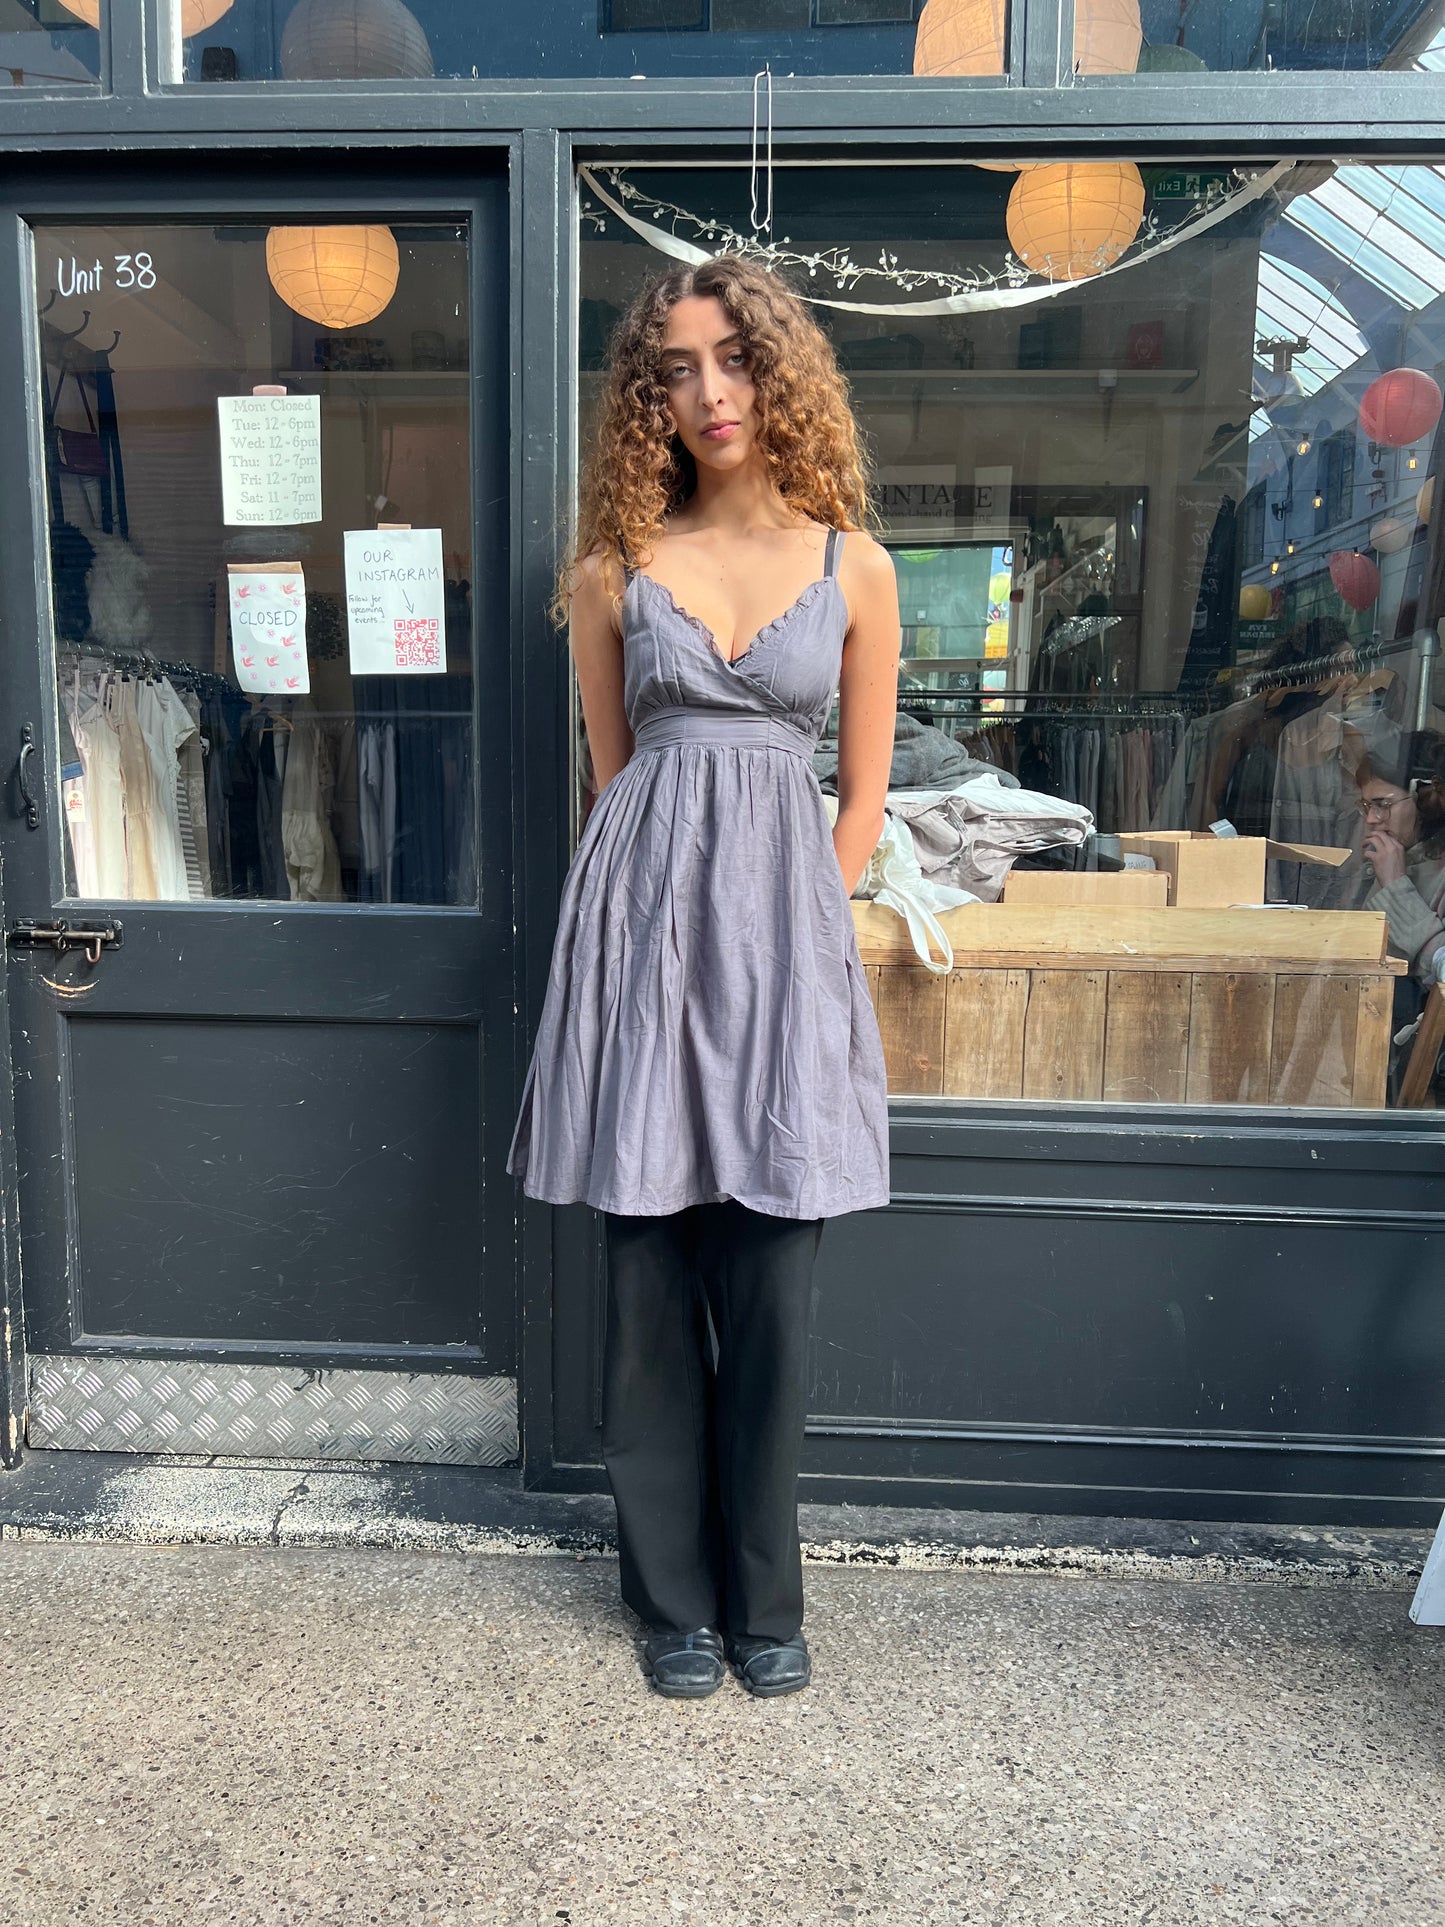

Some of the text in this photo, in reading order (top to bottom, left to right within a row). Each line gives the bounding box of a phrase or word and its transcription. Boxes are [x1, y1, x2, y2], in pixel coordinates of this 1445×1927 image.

[58, 252, 157, 297] Unit 38
[233, 399, 312, 413] Mon: Closed
[232, 419, 260, 430] Tue:
[265, 417, 279, 430] 12
[288, 417, 315, 432] 6pm
[230, 437, 265, 449] Wed:
[269, 436, 283, 448] 12
[293, 436, 319, 451] 6pm
[228, 455, 260, 467] Thu:
[268, 454, 282, 467] 12
[293, 454, 318, 469] 7pm
[240, 473, 262, 485] Fri:
[266, 472, 280, 485] 12
[291, 473, 315, 487] 7pm
[240, 491, 263, 503] Sat:
[268, 491, 280, 503] 11
[292, 491, 316, 505] 7pm
[236, 509, 264, 521] Sun:
[269, 508, 283, 521] 12
[293, 509, 317, 522] 6pm
[363, 549, 394, 563] OUR
[358, 567, 440, 582] INSTAGRAM
[348, 594, 382, 607] Follow for
[239, 610, 298, 627] CLOSED
[350, 607, 385, 619] upcoming
